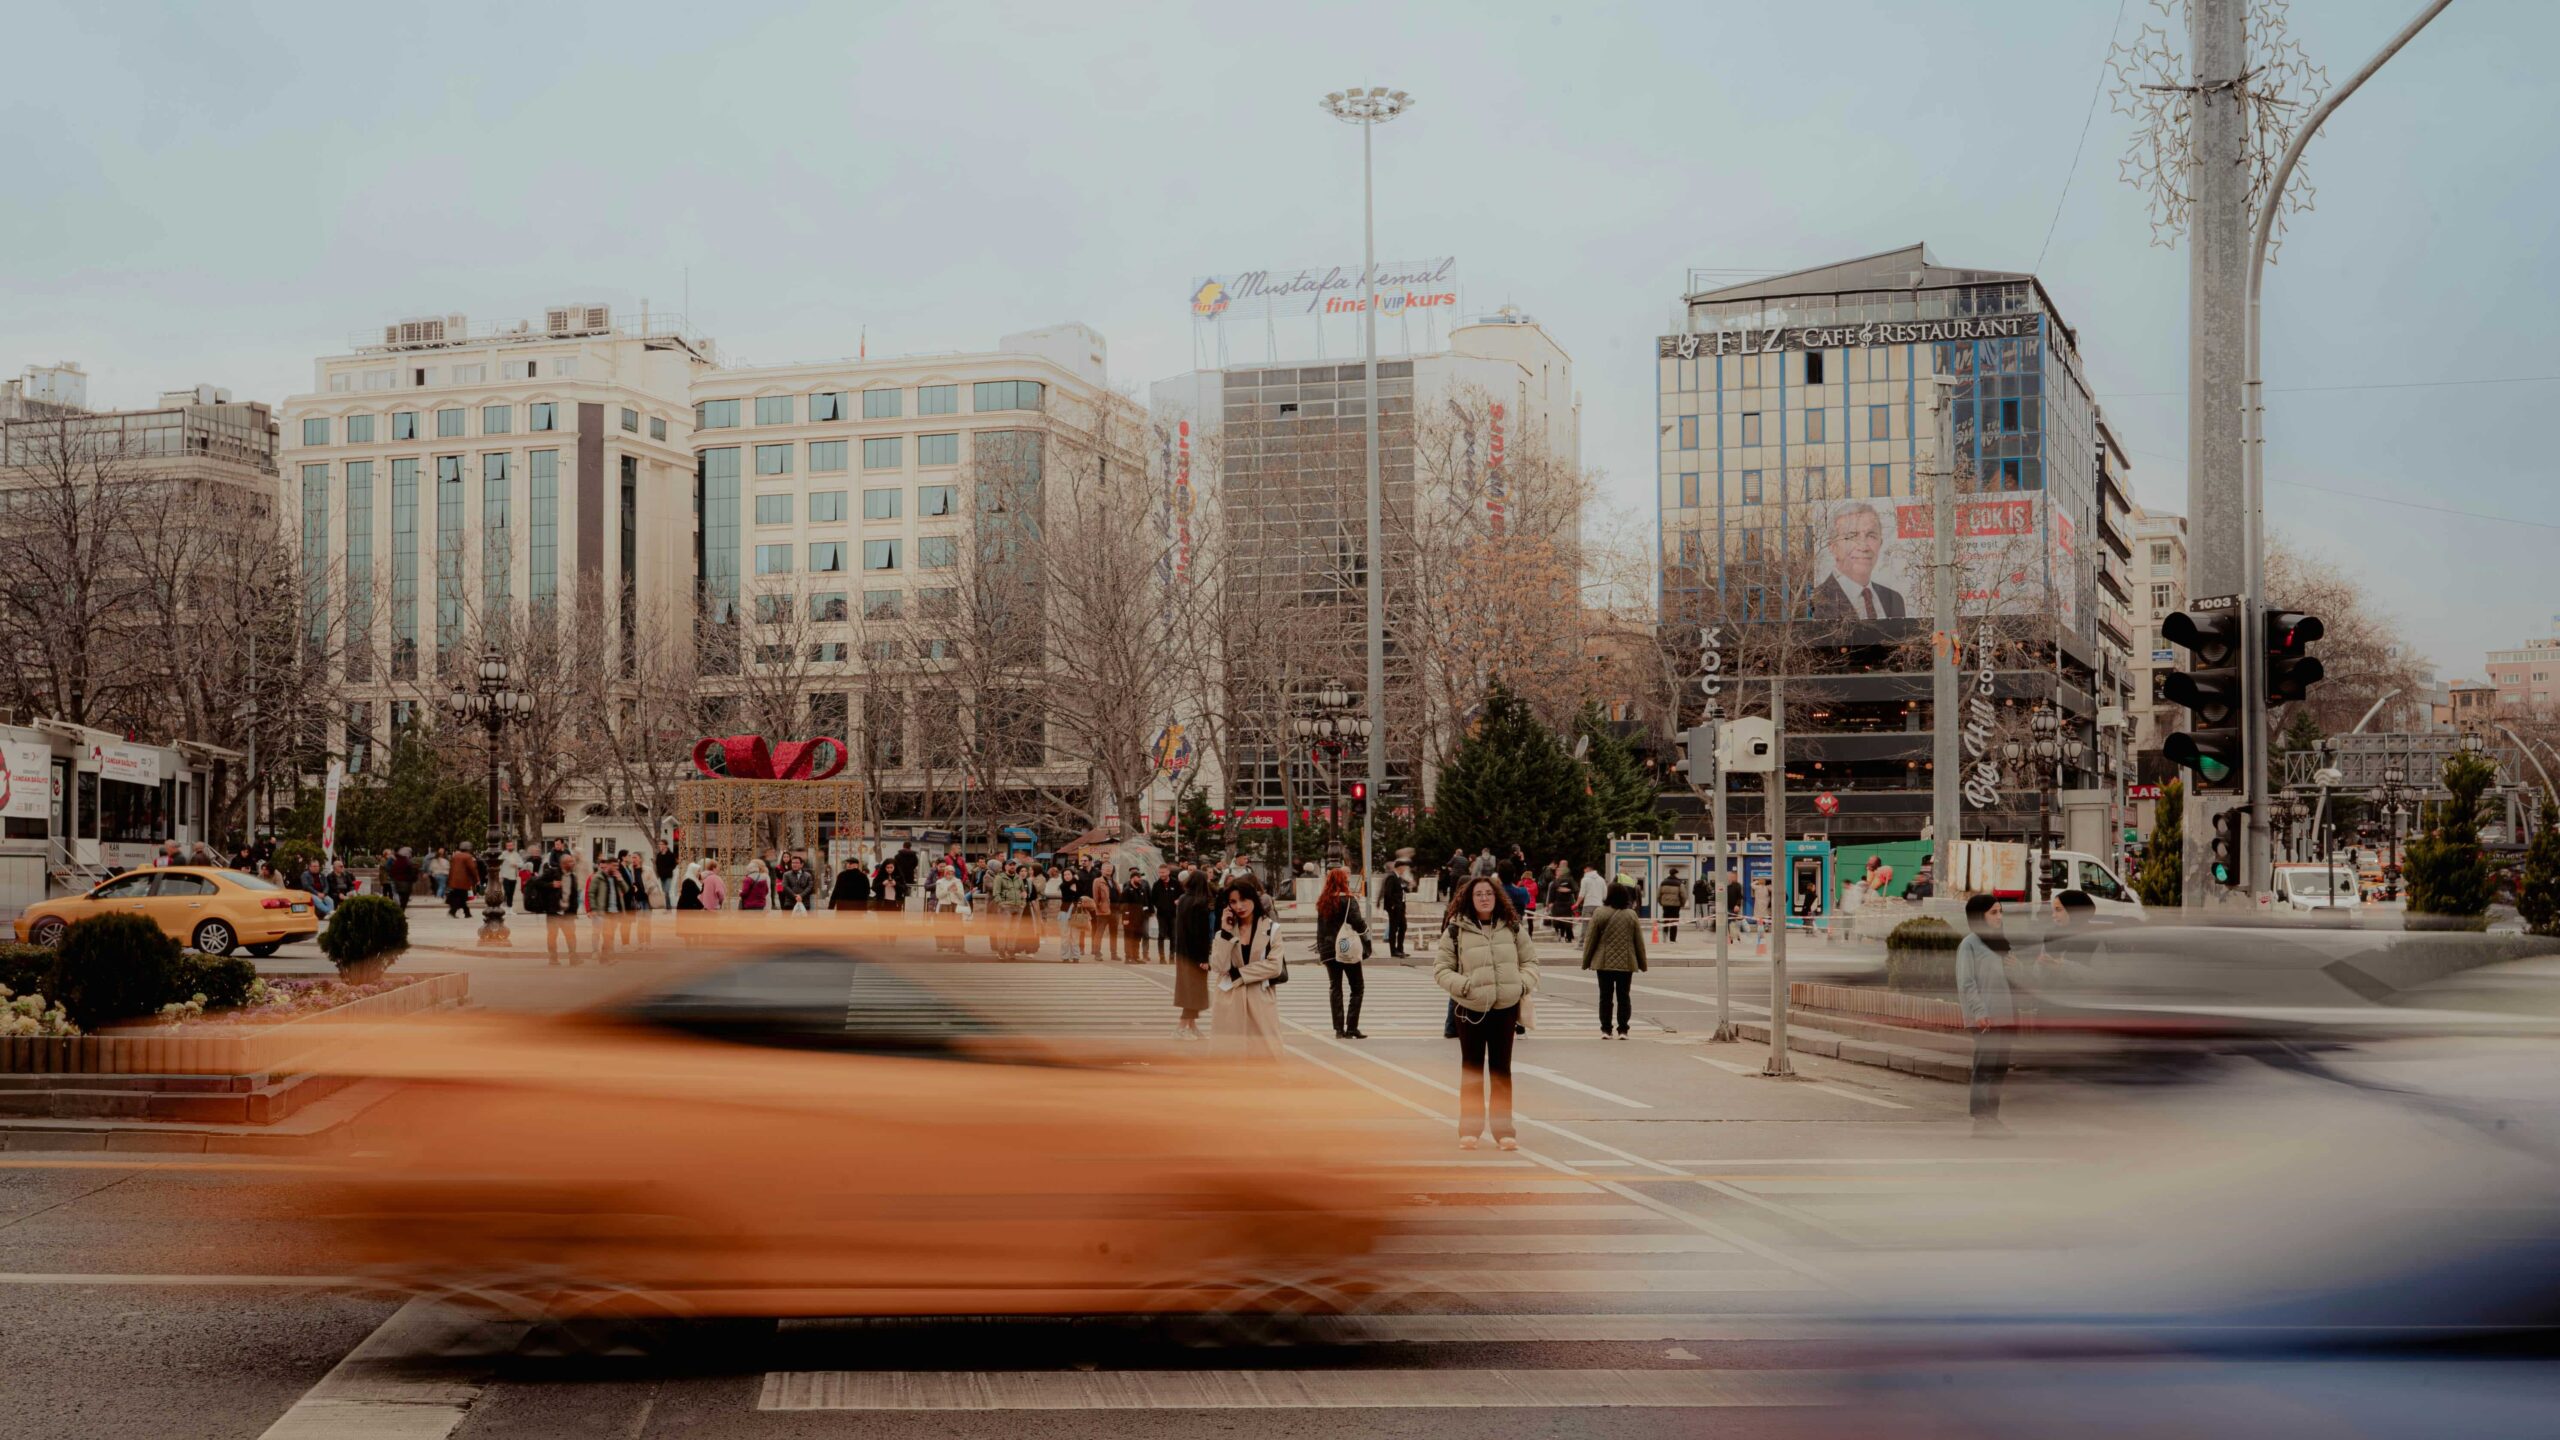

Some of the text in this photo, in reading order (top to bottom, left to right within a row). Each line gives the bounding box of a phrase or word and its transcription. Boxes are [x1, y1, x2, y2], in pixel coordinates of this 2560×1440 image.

[1191, 301, 1229, 314] final
[1232, 266, 1350, 313] Mustafa
[1325, 292, 1457, 314] final VIP kurs
[1715, 327, 1785, 356] FLZ
[1879, 318, 2022, 343] RESTAURANT
[1176, 421, 1190, 486] kurs
[1487, 403, 1505, 469] kurs
[1969, 506, 2003, 534] ÇOK
[2198, 597, 2232, 610] 1003
[1963, 698, 1996, 758] Hill
[1820, 796, 1832, 804] M
[1964, 762, 2000, 808] Big
